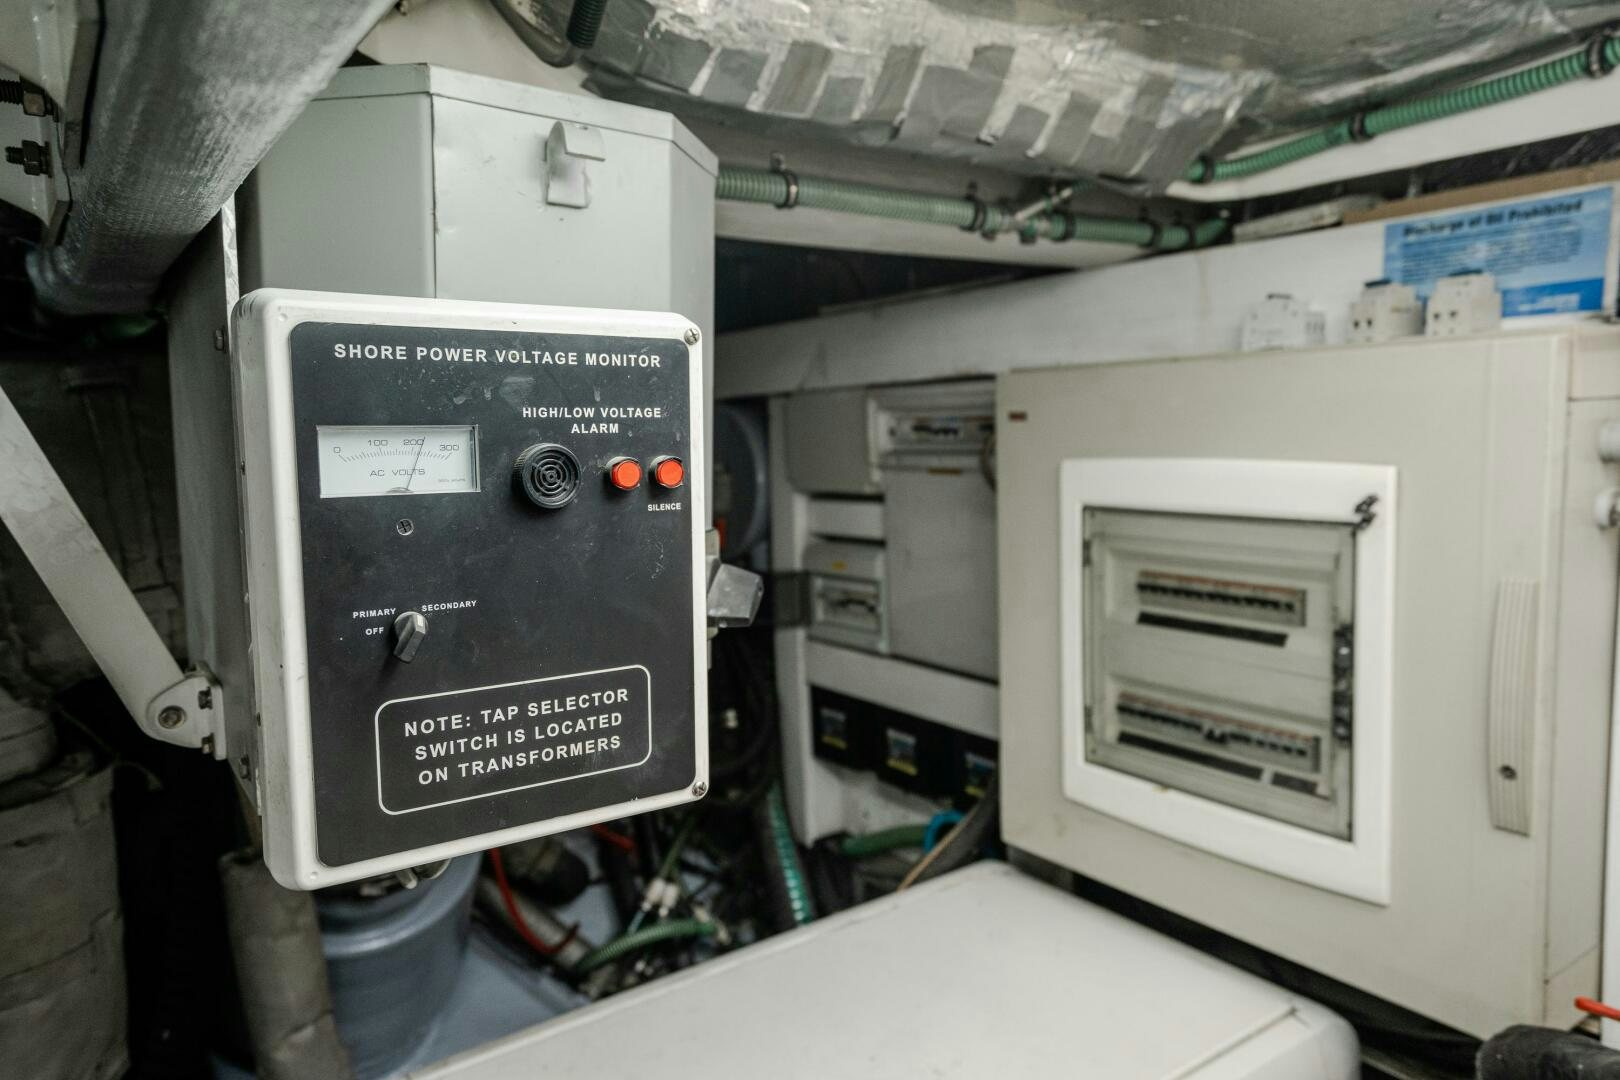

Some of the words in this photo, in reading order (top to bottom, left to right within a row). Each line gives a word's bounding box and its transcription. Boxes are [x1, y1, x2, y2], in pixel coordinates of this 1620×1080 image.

[1469, 215, 1482, 228] of
[1508, 199, 1583, 220] Prohibited
[335, 344, 407, 359] SHORE
[417, 347, 487, 362] POWER
[495, 350, 577, 364] VOLTAGE
[586, 353, 660, 367] MONITOR
[523, 407, 594, 417] HIGH/LOW
[600, 408, 661, 417] VOLTAGE
[571, 423, 618, 433] ALARM
[367, 439, 388, 447] 100
[403, 438, 424, 446] 200
[439, 444, 460, 452] 300
[369, 469, 385, 477] AC
[391, 468, 426, 476] VOLTS
[648, 503, 681, 511] SILENCE
[422, 601, 476, 611] SECONDARY
[353, 607, 396, 618] PRIMARY
[366, 627, 384, 635] OFF
[405, 714, 471, 737] NOTE:
[481, 706, 518, 724] TAP
[528, 688, 629, 717] SELECTOR
[415, 733, 497, 760] SWITCH
[508, 729, 525, 744] IS
[535, 712, 622, 740] LOCATED
[419, 767, 447, 784] ON
[458, 736, 621, 777] TRANSFORMERS
